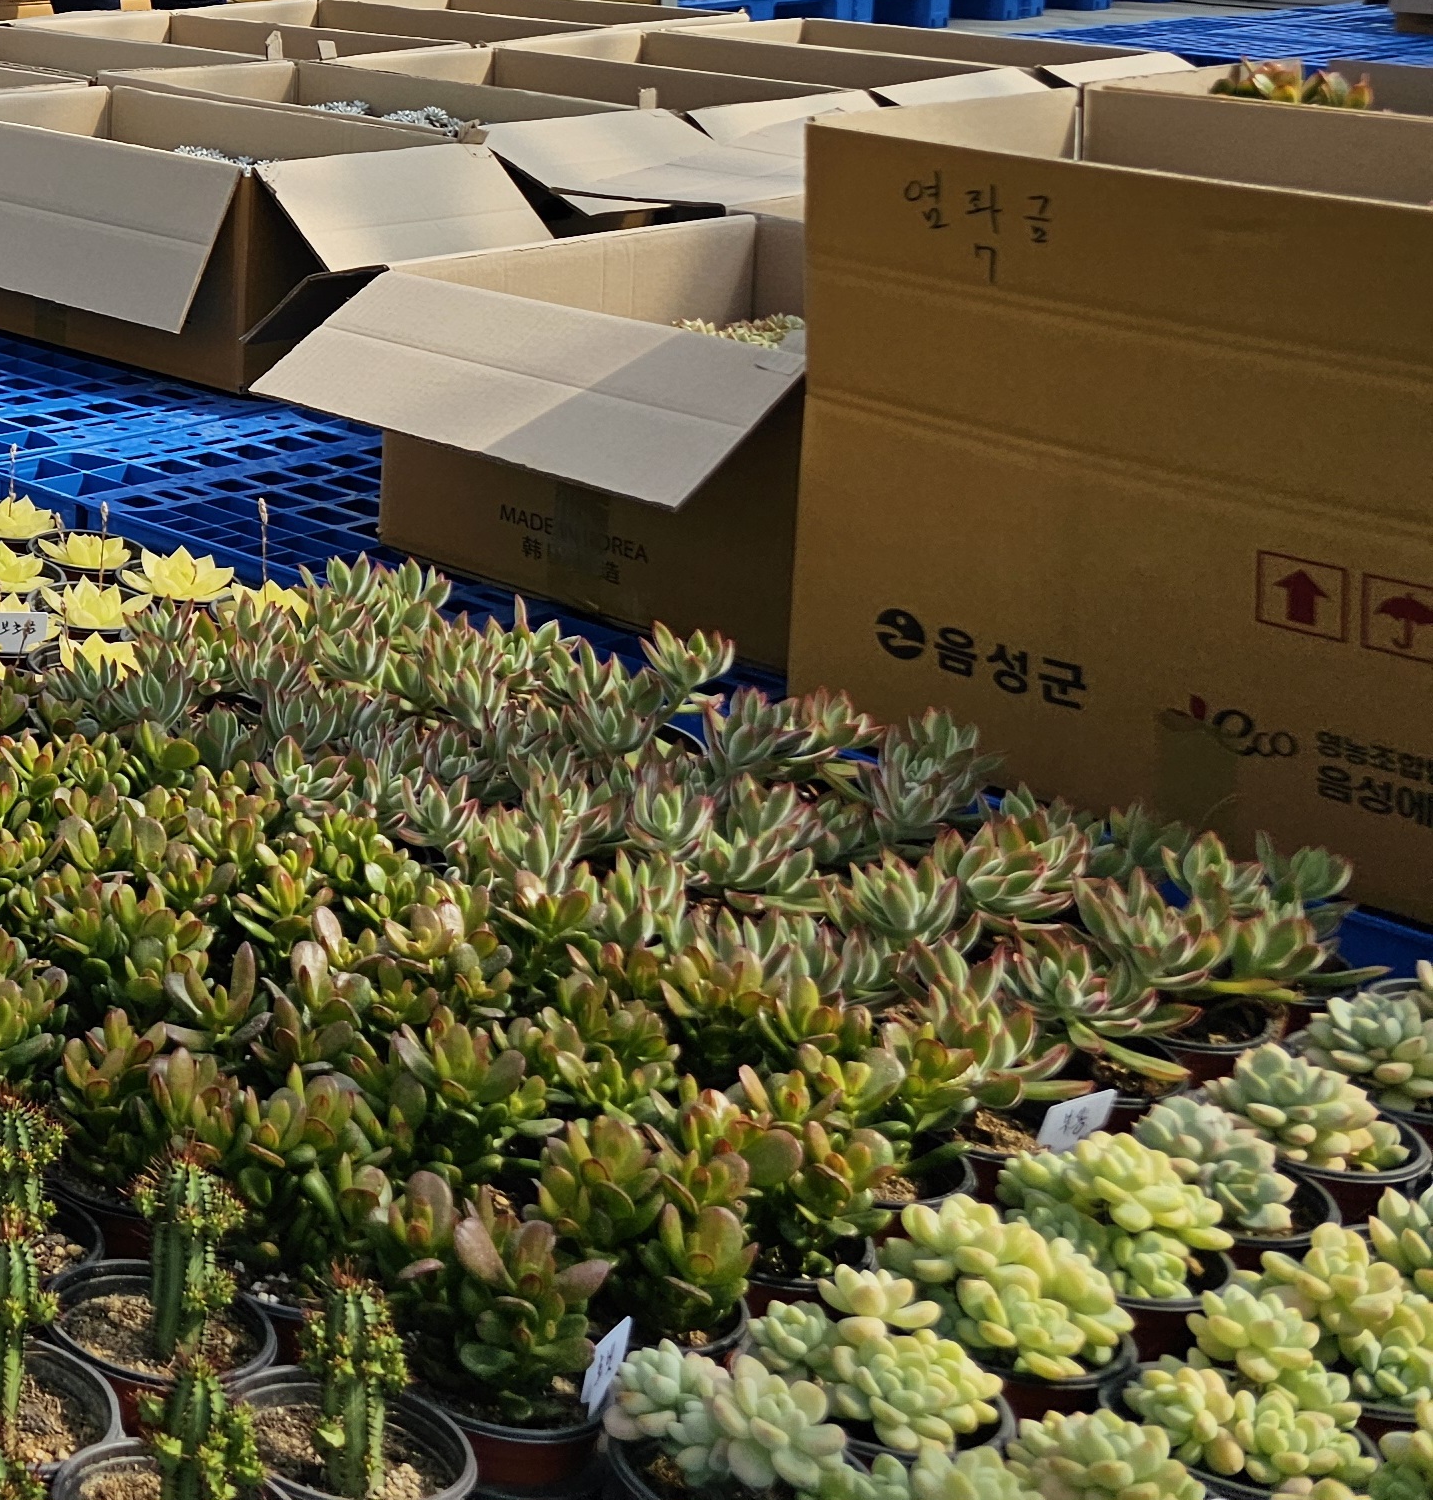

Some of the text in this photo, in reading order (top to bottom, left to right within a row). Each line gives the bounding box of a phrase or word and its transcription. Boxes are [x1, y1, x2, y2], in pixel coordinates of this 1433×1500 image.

[973, 242, 998, 284] 7
[498, 504, 555, 535] MADE
[933, 626, 1088, 711] 음성군
[1211, 708, 1301, 758] eco
[1316, 730, 1433, 786] 영농조합
